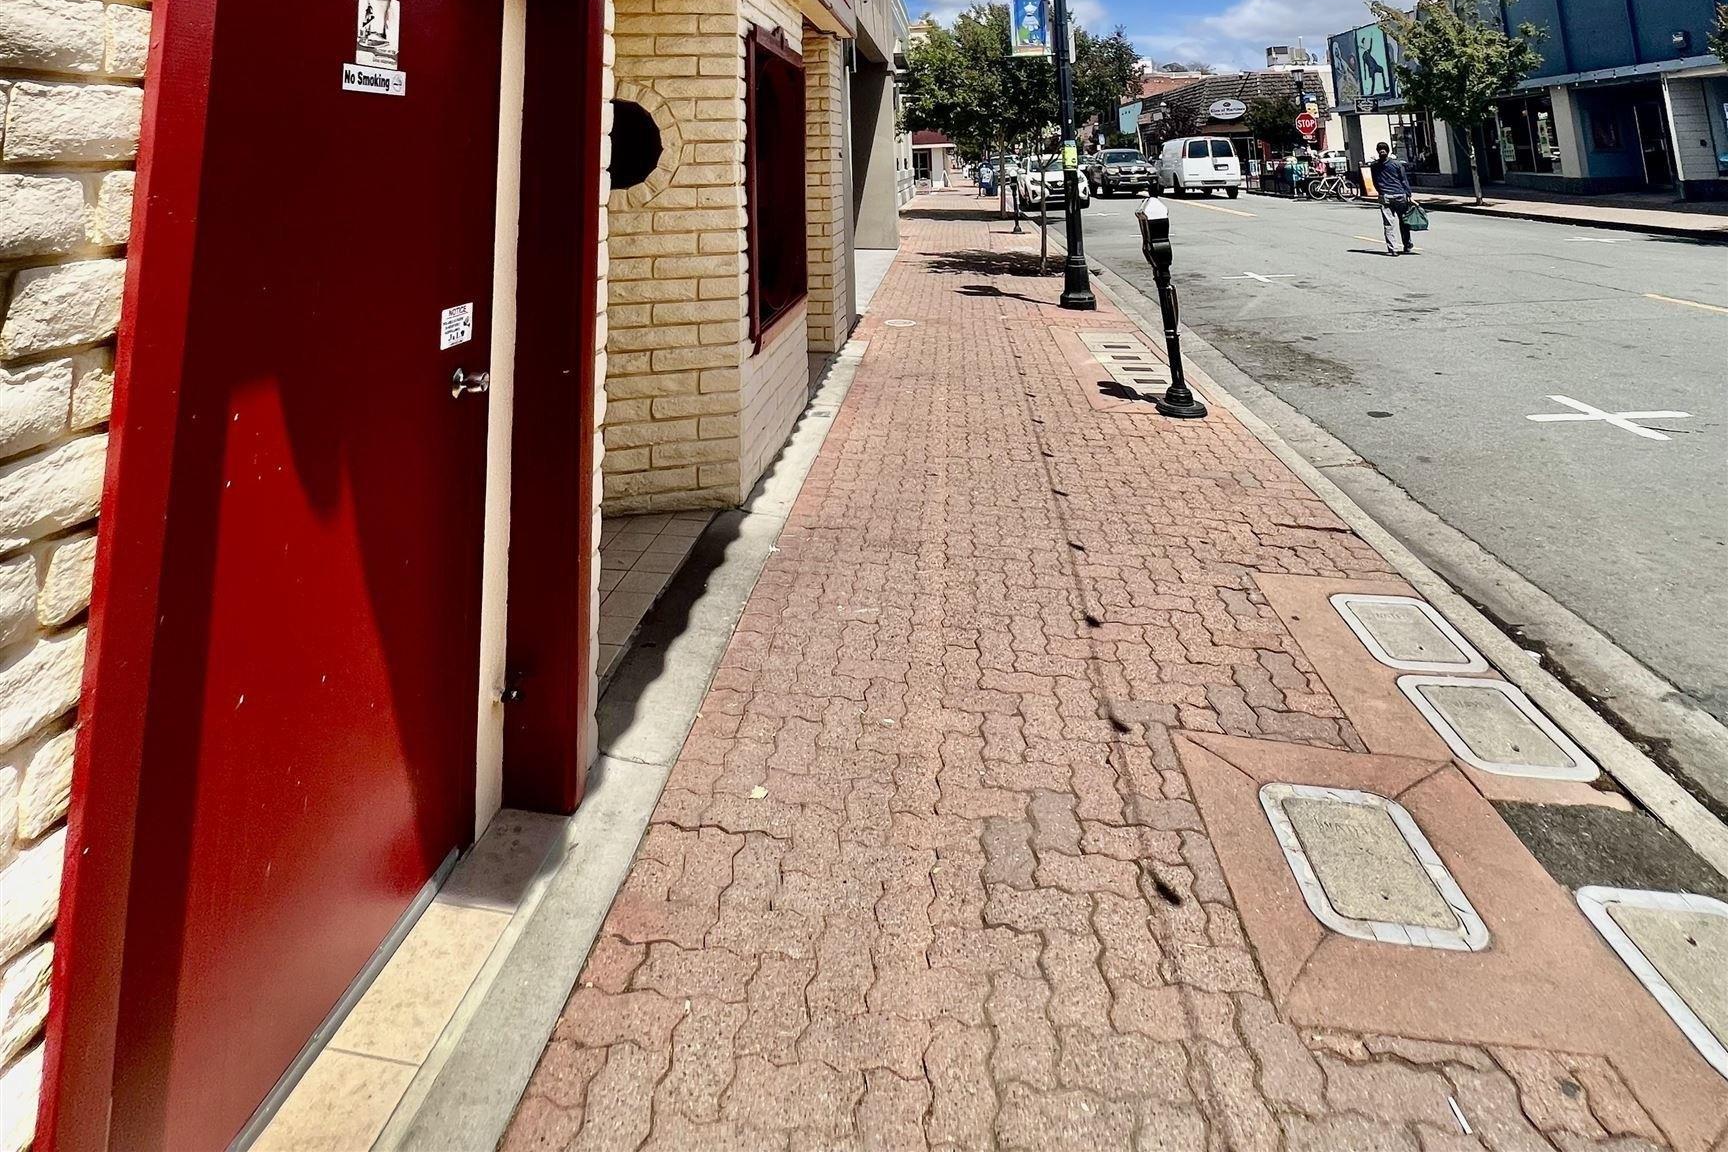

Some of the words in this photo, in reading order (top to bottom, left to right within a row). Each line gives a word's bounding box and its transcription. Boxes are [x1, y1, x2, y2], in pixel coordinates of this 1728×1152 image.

[344, 69, 356, 84] No
[357, 71, 390, 92] Smoking
[1297, 119, 1315, 128] STOP
[448, 305, 467, 317] NOTICE
